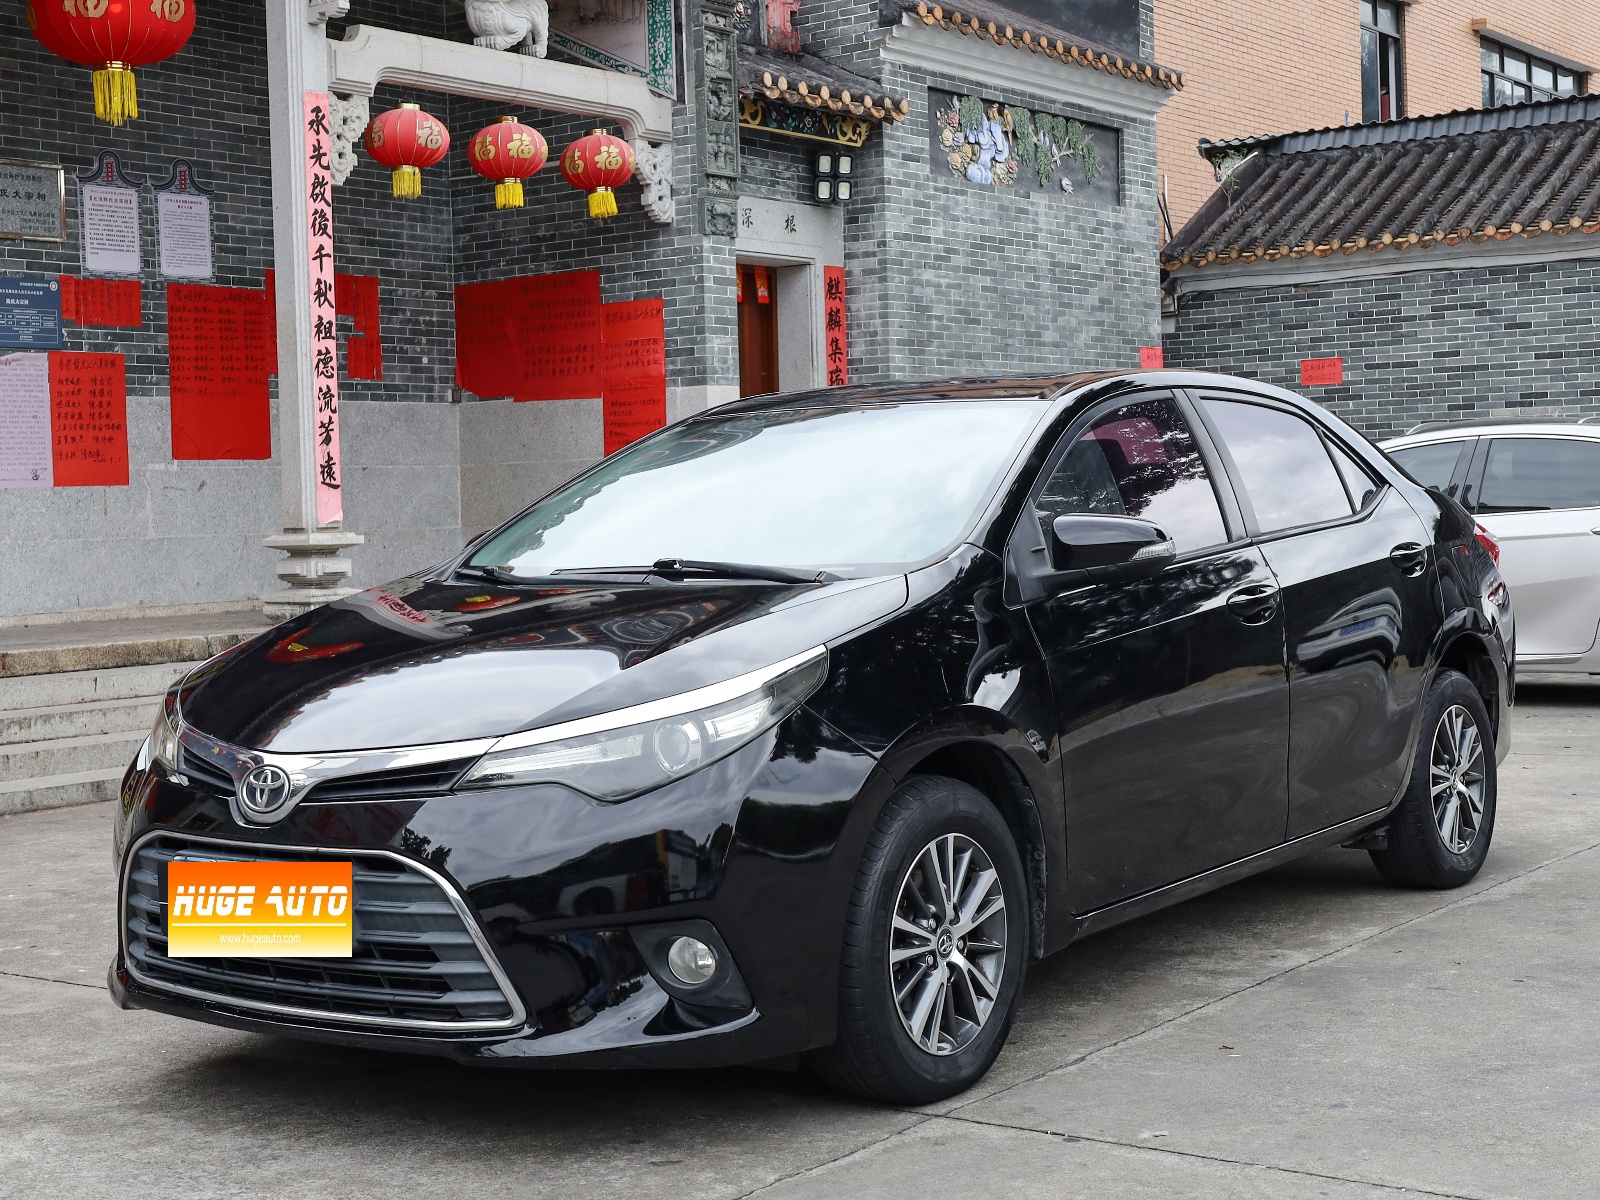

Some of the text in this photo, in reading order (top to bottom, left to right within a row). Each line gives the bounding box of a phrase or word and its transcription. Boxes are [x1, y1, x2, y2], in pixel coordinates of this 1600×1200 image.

[417, 121, 443, 150] 福
[474, 135, 496, 161] 福
[507, 134, 535, 160] 福
[565, 148, 585, 175] 福
[595, 145, 622, 170] 福
